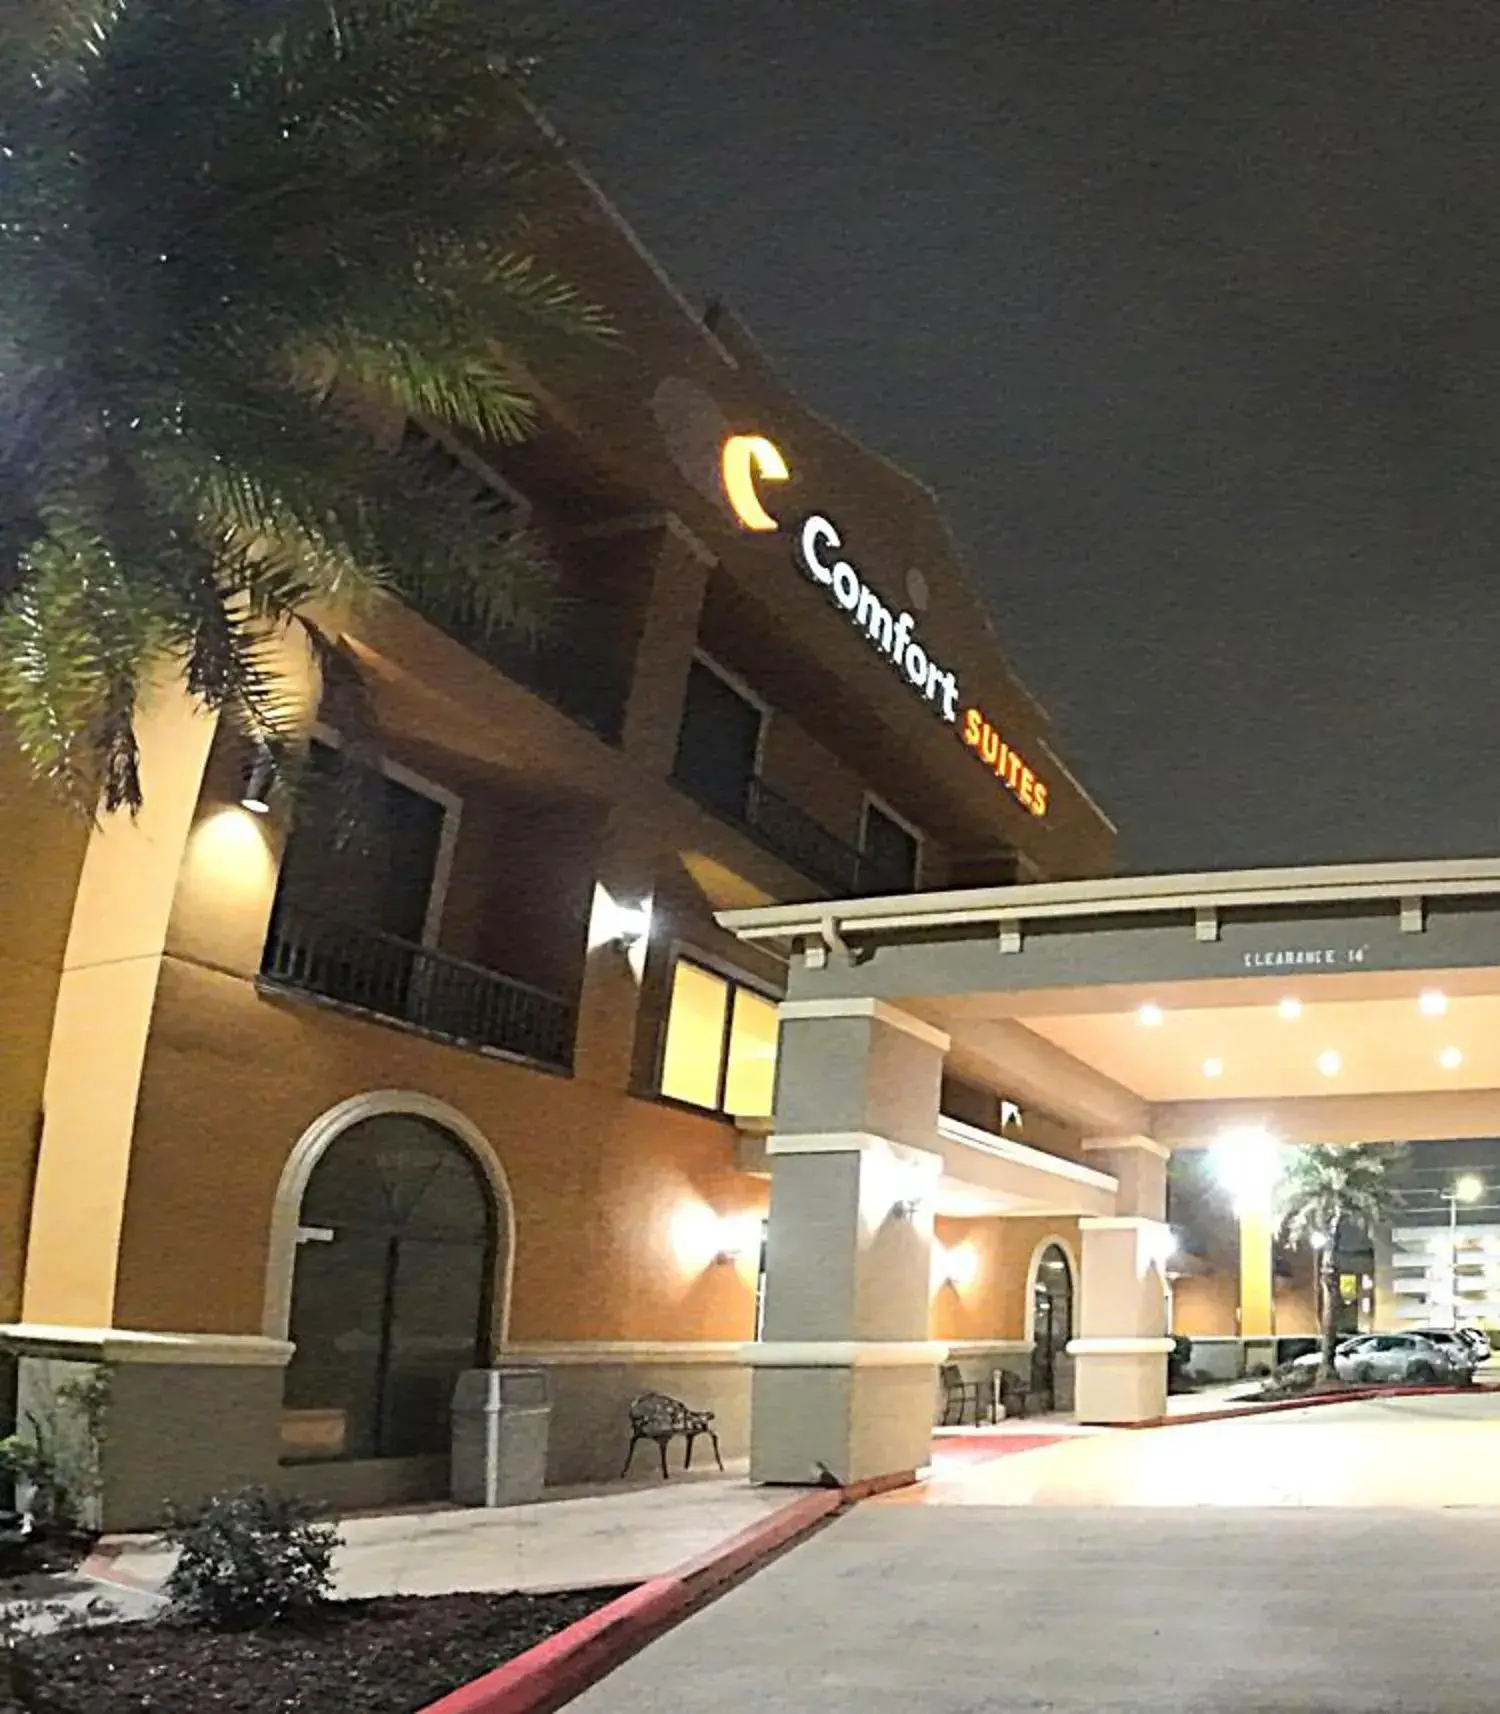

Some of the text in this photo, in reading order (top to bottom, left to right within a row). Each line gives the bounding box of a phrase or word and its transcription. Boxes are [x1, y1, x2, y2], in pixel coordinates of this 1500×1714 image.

[800, 514, 1050, 818] Comfort SUITES
[1243, 949, 1337, 968] CLEARANCE
